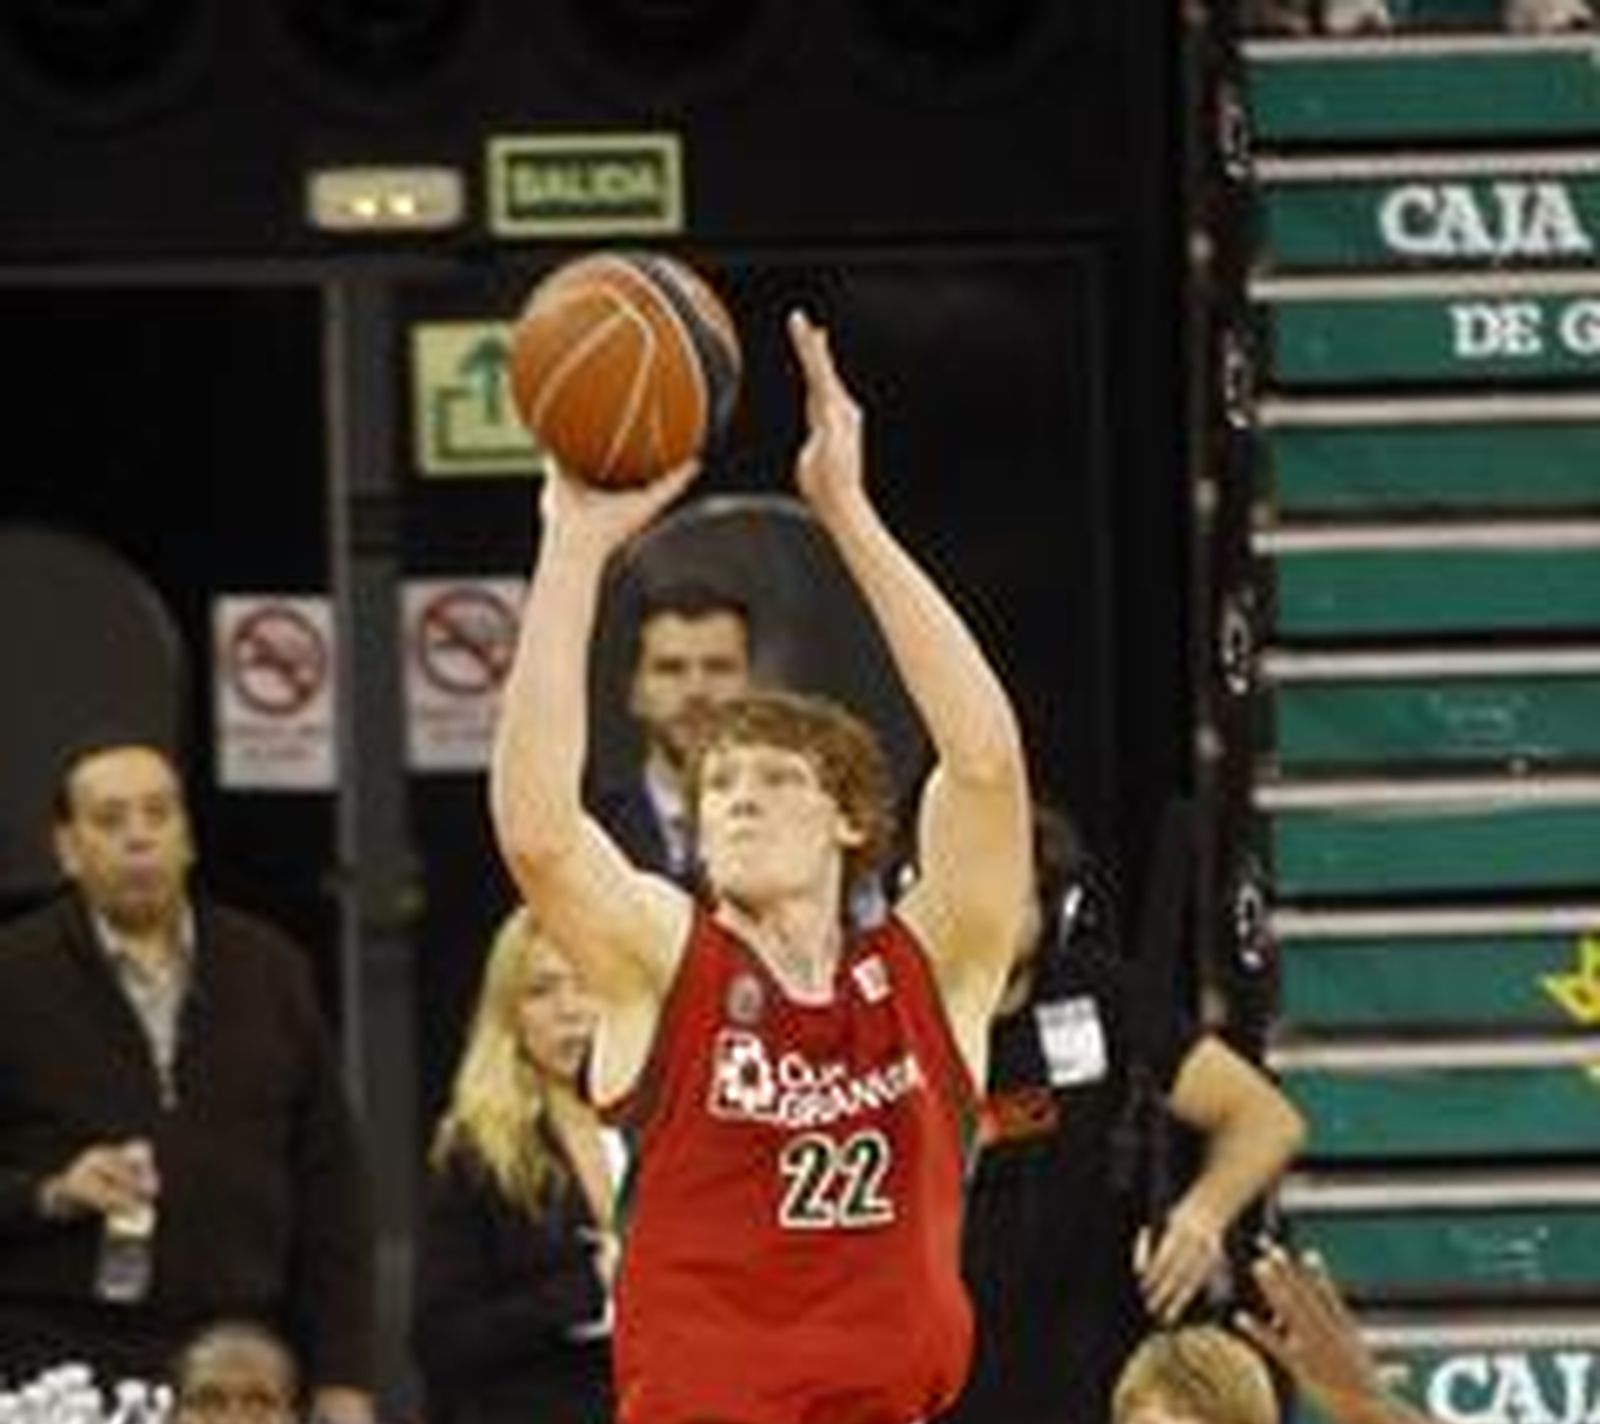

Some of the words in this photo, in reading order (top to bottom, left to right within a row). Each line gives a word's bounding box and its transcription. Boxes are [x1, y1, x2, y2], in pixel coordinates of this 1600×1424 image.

[1379, 181, 1593, 255] CAJA
[1449, 303, 1543, 356] DE
[779, 1130, 894, 1229] 22
